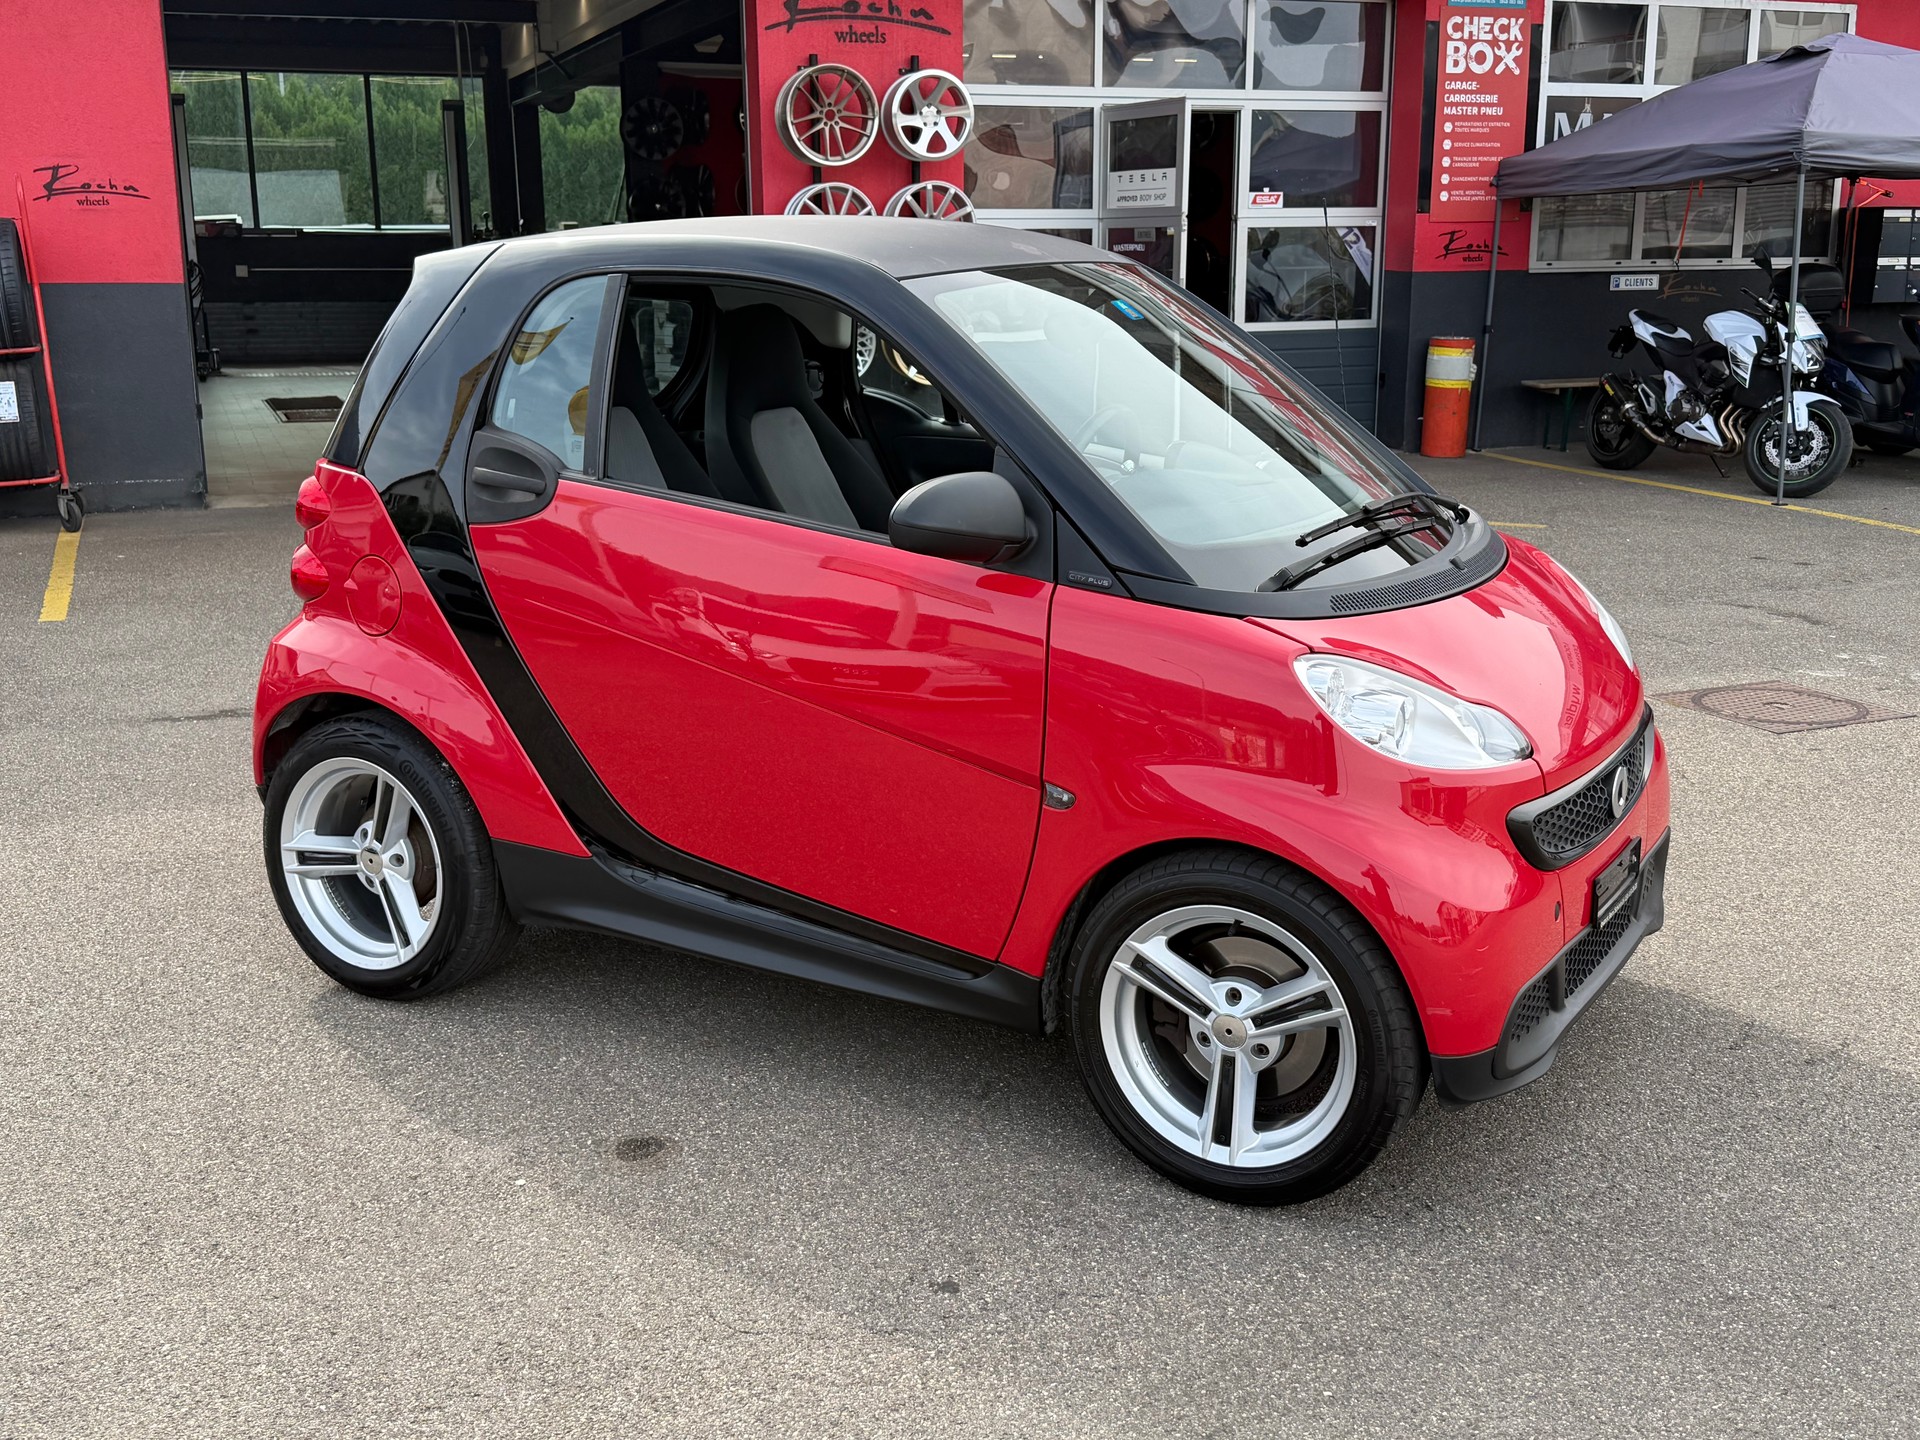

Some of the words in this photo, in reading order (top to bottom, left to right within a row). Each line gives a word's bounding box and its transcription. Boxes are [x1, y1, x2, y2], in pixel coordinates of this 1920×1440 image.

[1446, 15, 1525, 41] CHECK
[834, 25, 887, 44] wheels
[1445, 40, 1523, 75] BOX
[1445, 81, 1480, 90] GARAGE-
[1444, 94, 1498, 103] CARROSSERIE
[1443, 106, 1478, 115] MASTER
[1480, 107, 1503, 115] PNEU
[1117, 172, 1168, 183] TESLA
[76, 195, 110, 206] wheels
[1139, 194, 1152, 202] BODY
[1462, 254, 1484, 262] wheels
[1625, 278, 1654, 287] CLIENTS
[1069, 573, 1086, 581] CITY
[1088, 577, 1109, 586] PLUS
[399, 760, 453, 833] Continental
